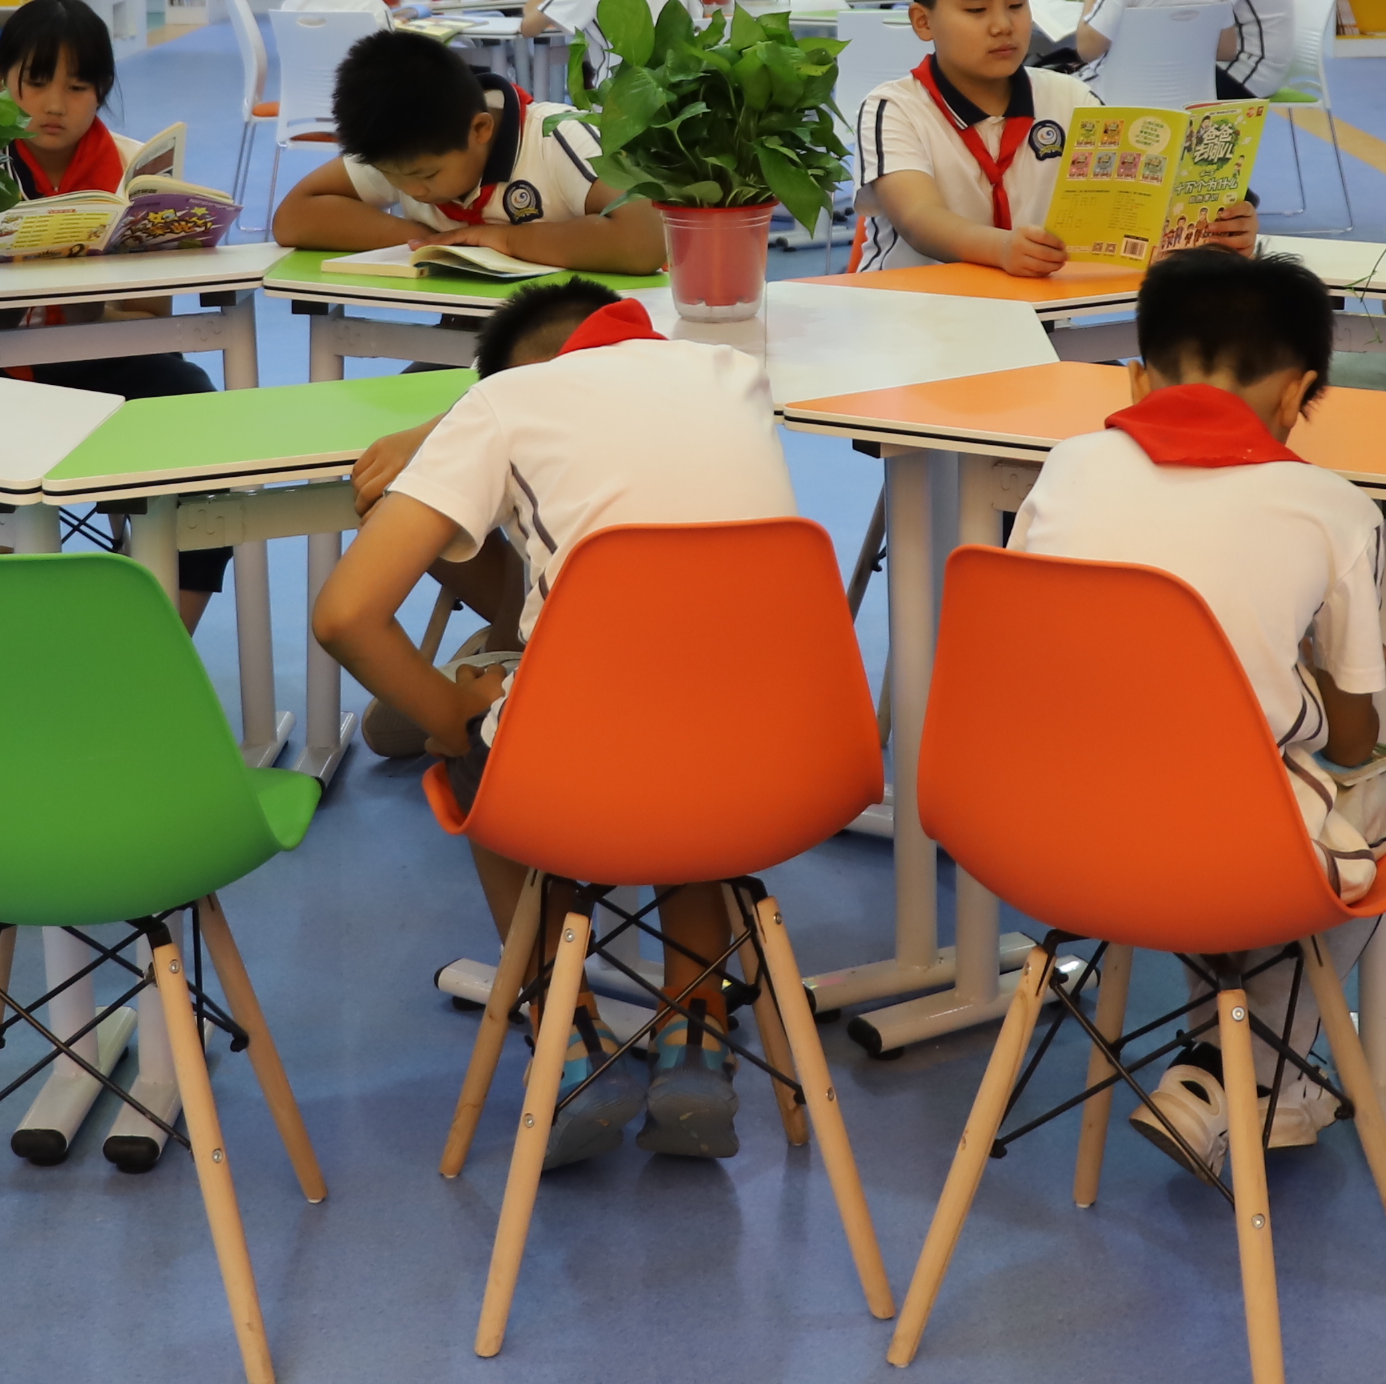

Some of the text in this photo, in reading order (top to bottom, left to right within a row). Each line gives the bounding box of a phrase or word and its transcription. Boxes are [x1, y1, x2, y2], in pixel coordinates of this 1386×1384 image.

[1203, 123, 1234, 144] 爸爸
[1194, 142, 1235, 163] 去哪儿
[1175, 177, 1239, 196] 十万个为什么
